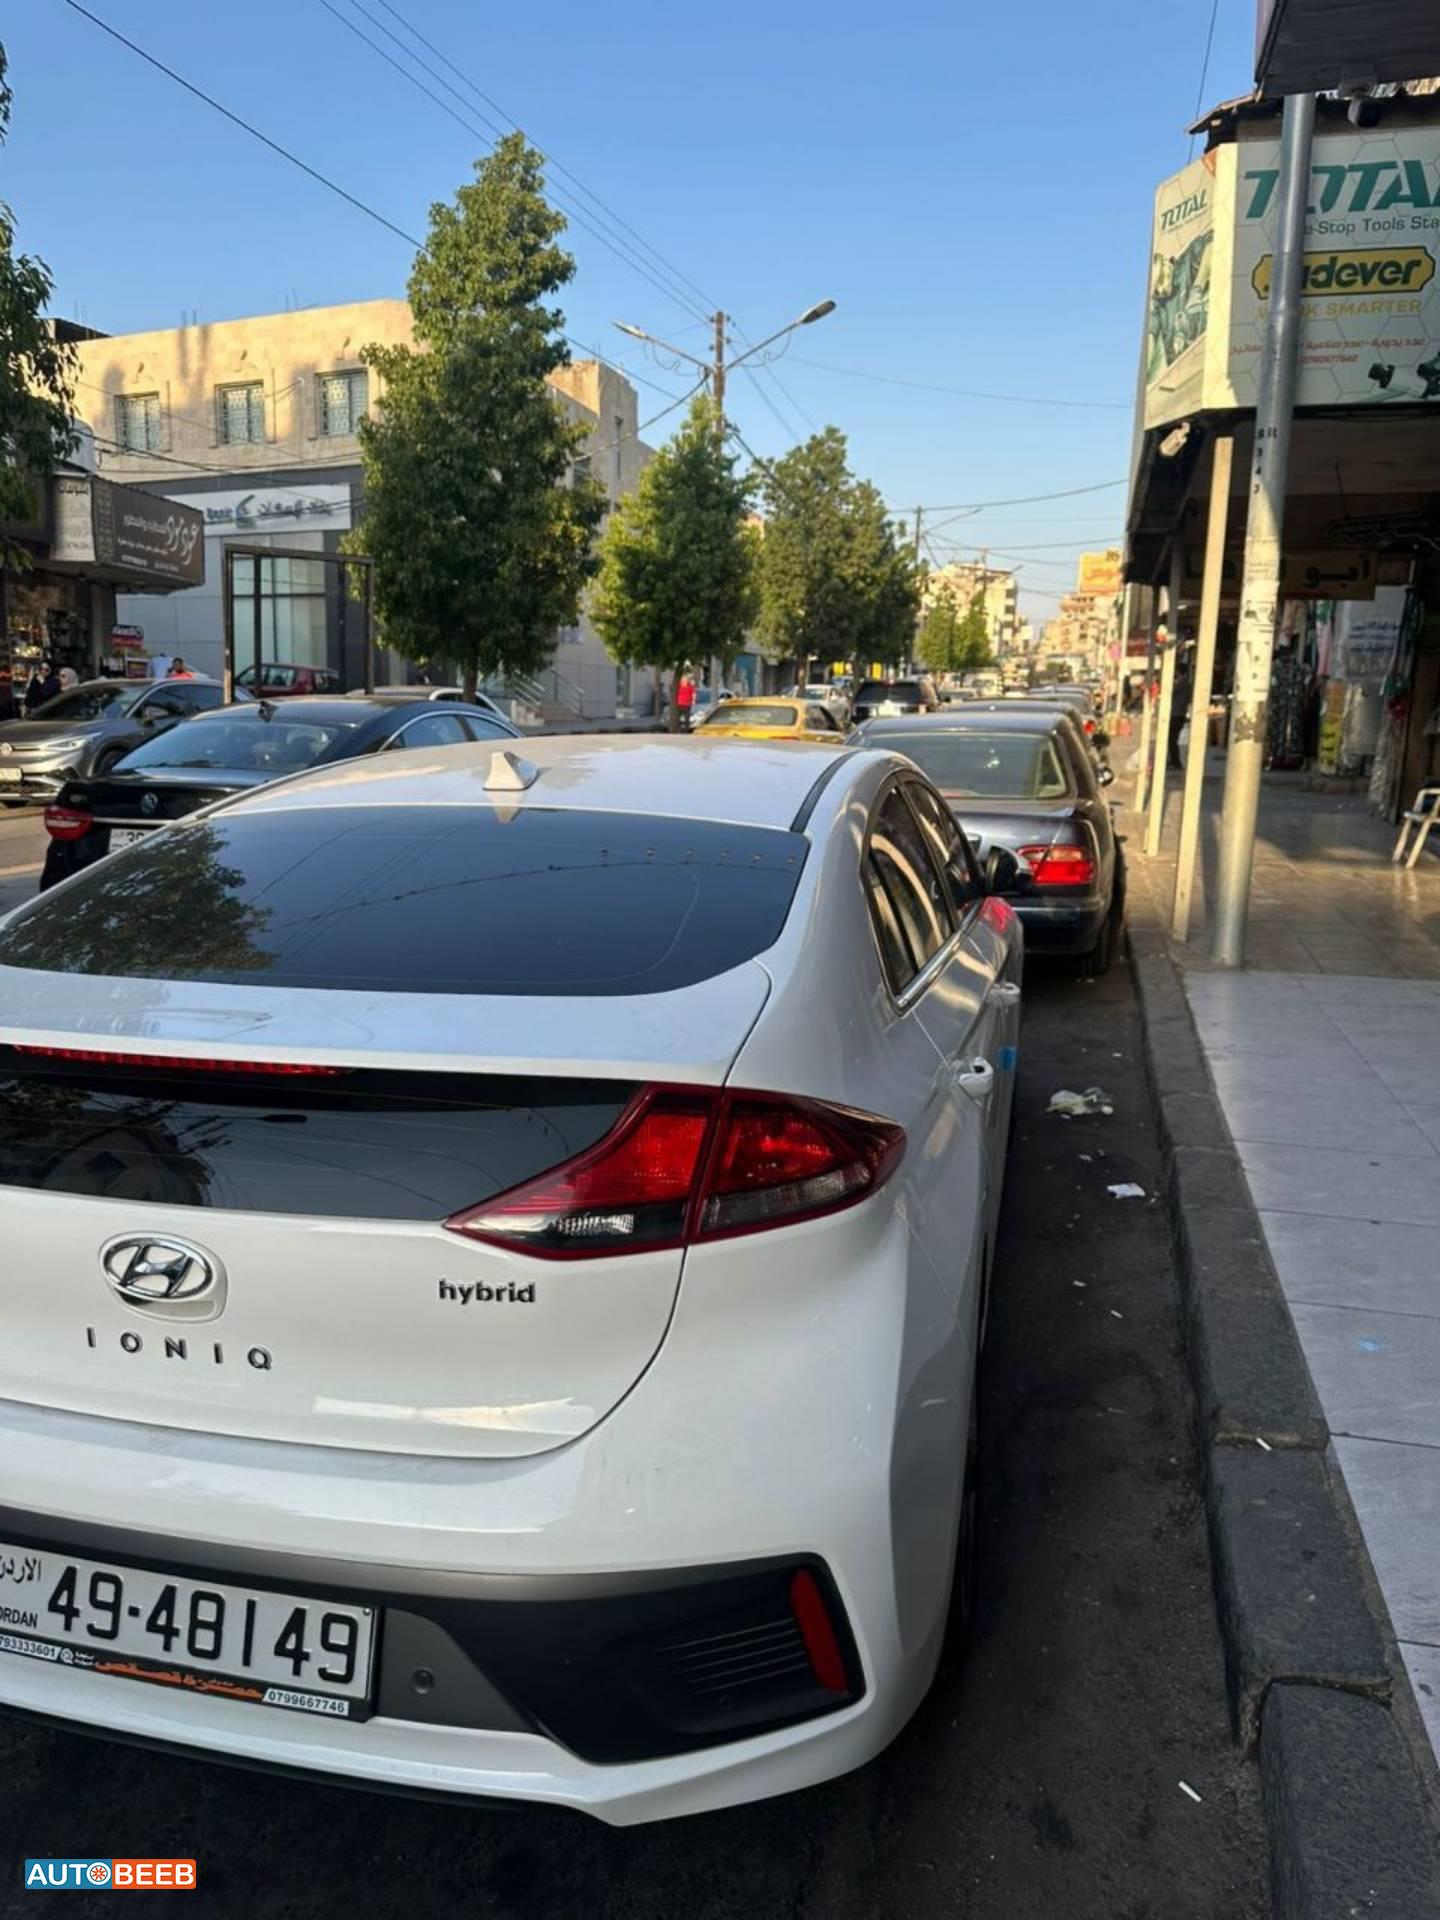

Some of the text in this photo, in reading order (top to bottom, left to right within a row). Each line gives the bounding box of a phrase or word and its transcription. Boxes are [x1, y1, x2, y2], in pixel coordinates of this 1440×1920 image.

[1244, 159, 1440, 219] TOTA
[1162, 188, 1208, 231] TOTAL
[1362, 216, 1406, 232] Tools
[1326, 299, 1422, 317] SMARTER
[437, 1278, 536, 1305] hybrid
[86, 1326, 273, 1371] IONIQ
[47, 1565, 360, 1685] 49-48149
[268, 1690, 346, 1714] 0799667746
